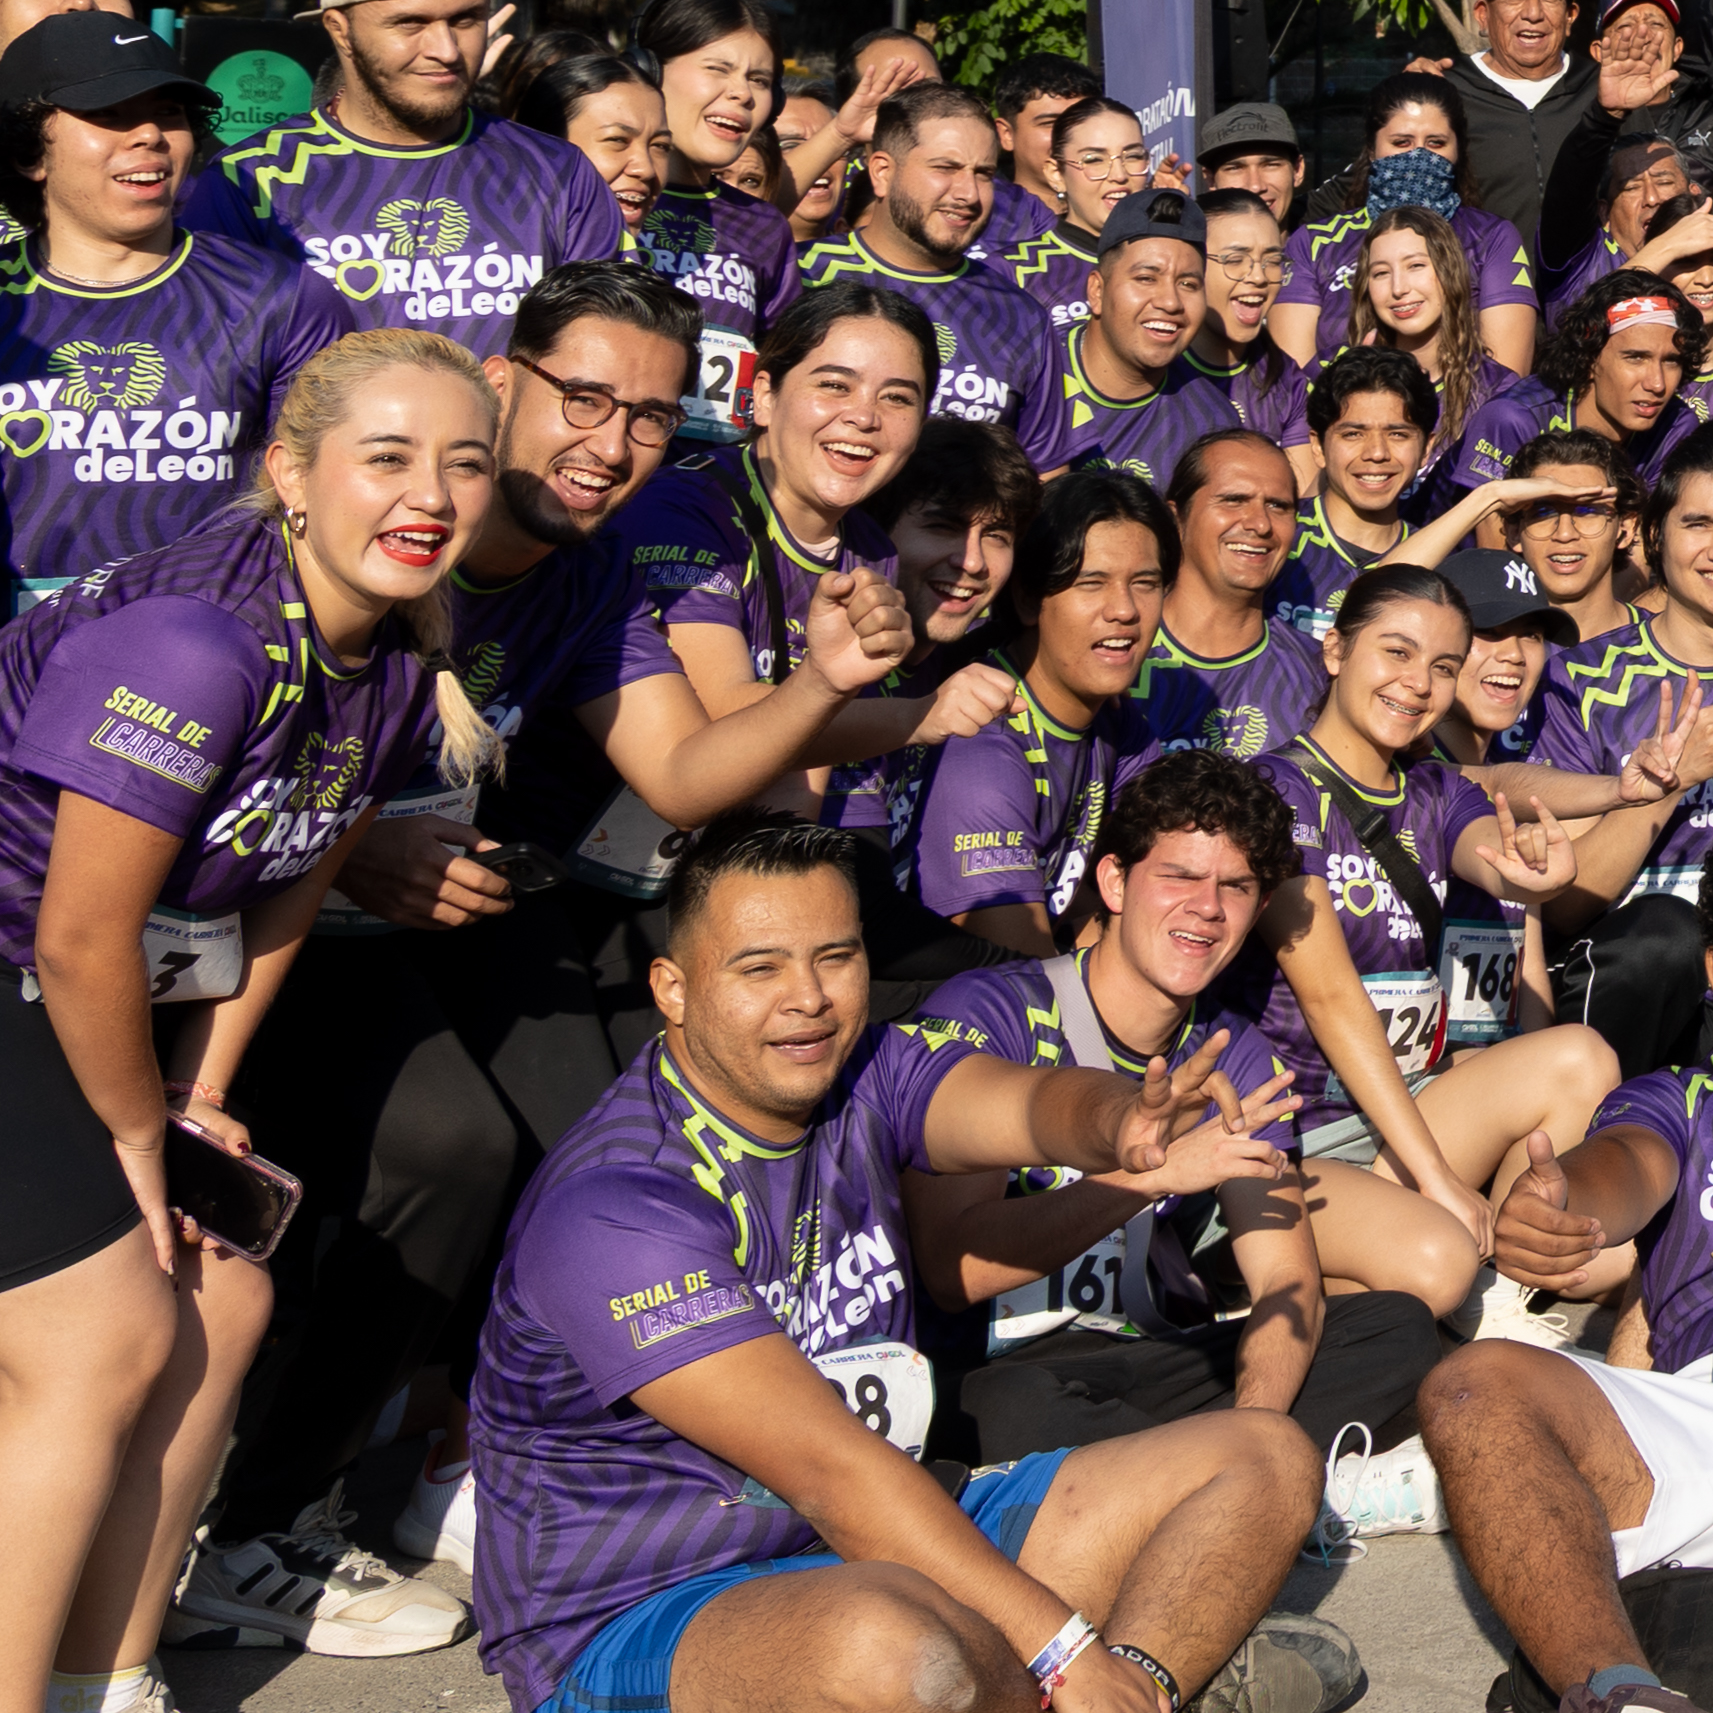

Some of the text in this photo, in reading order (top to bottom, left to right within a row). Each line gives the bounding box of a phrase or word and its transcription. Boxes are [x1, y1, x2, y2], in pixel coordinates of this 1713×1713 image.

[304, 232, 391, 268] SOY
[0, 377, 62, 428] OY
[74, 438, 236, 484] deLeón
[633, 545, 719, 566] SERIAL DE
[104, 685, 213, 749] SERIAL DE
[955, 829, 1024, 853] SERIAL DE
[1462, 951, 1517, 1003] 168
[964, 1026, 989, 1049] DE
[609, 1269, 711, 1322] SERIAL DE
[820, 1351, 874, 1367] CARRERA
